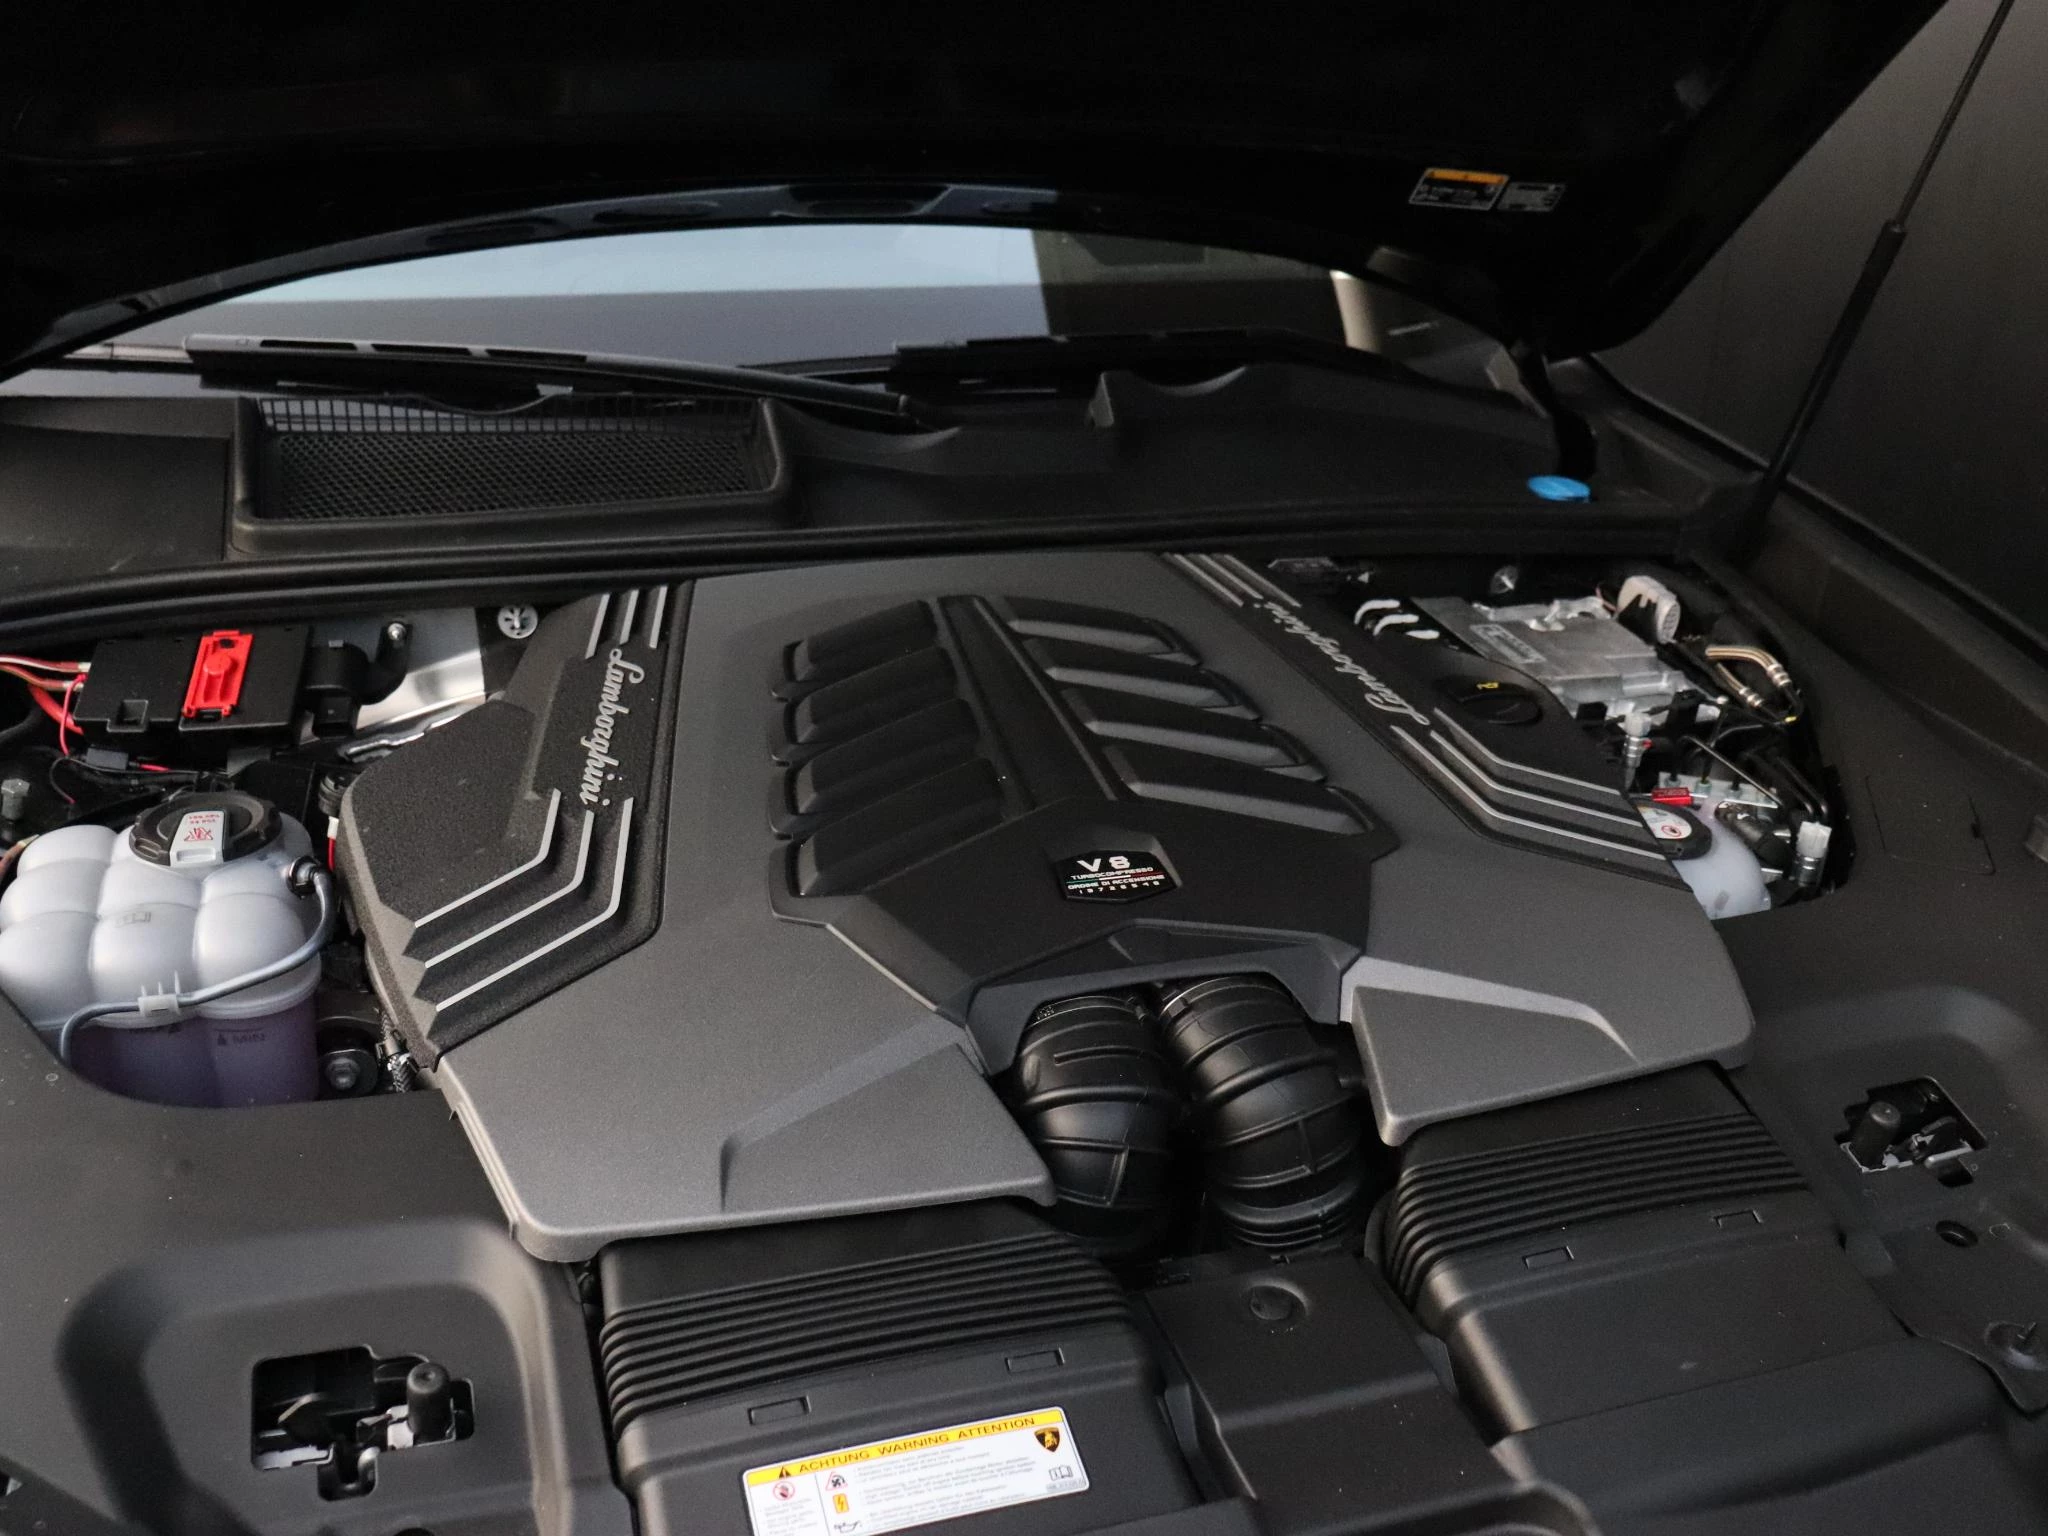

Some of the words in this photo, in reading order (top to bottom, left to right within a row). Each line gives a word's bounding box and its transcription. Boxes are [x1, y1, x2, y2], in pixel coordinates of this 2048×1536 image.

[1253, 601, 1430, 726] Lamborghini
[580, 648, 645, 806] Lamborghini
[1077, 856, 1130, 872] V8
[799, 1450, 870, 1474] ACHTUNG
[877, 1433, 950, 1456] WARNING
[957, 1416, 1035, 1439] ATTENTION
